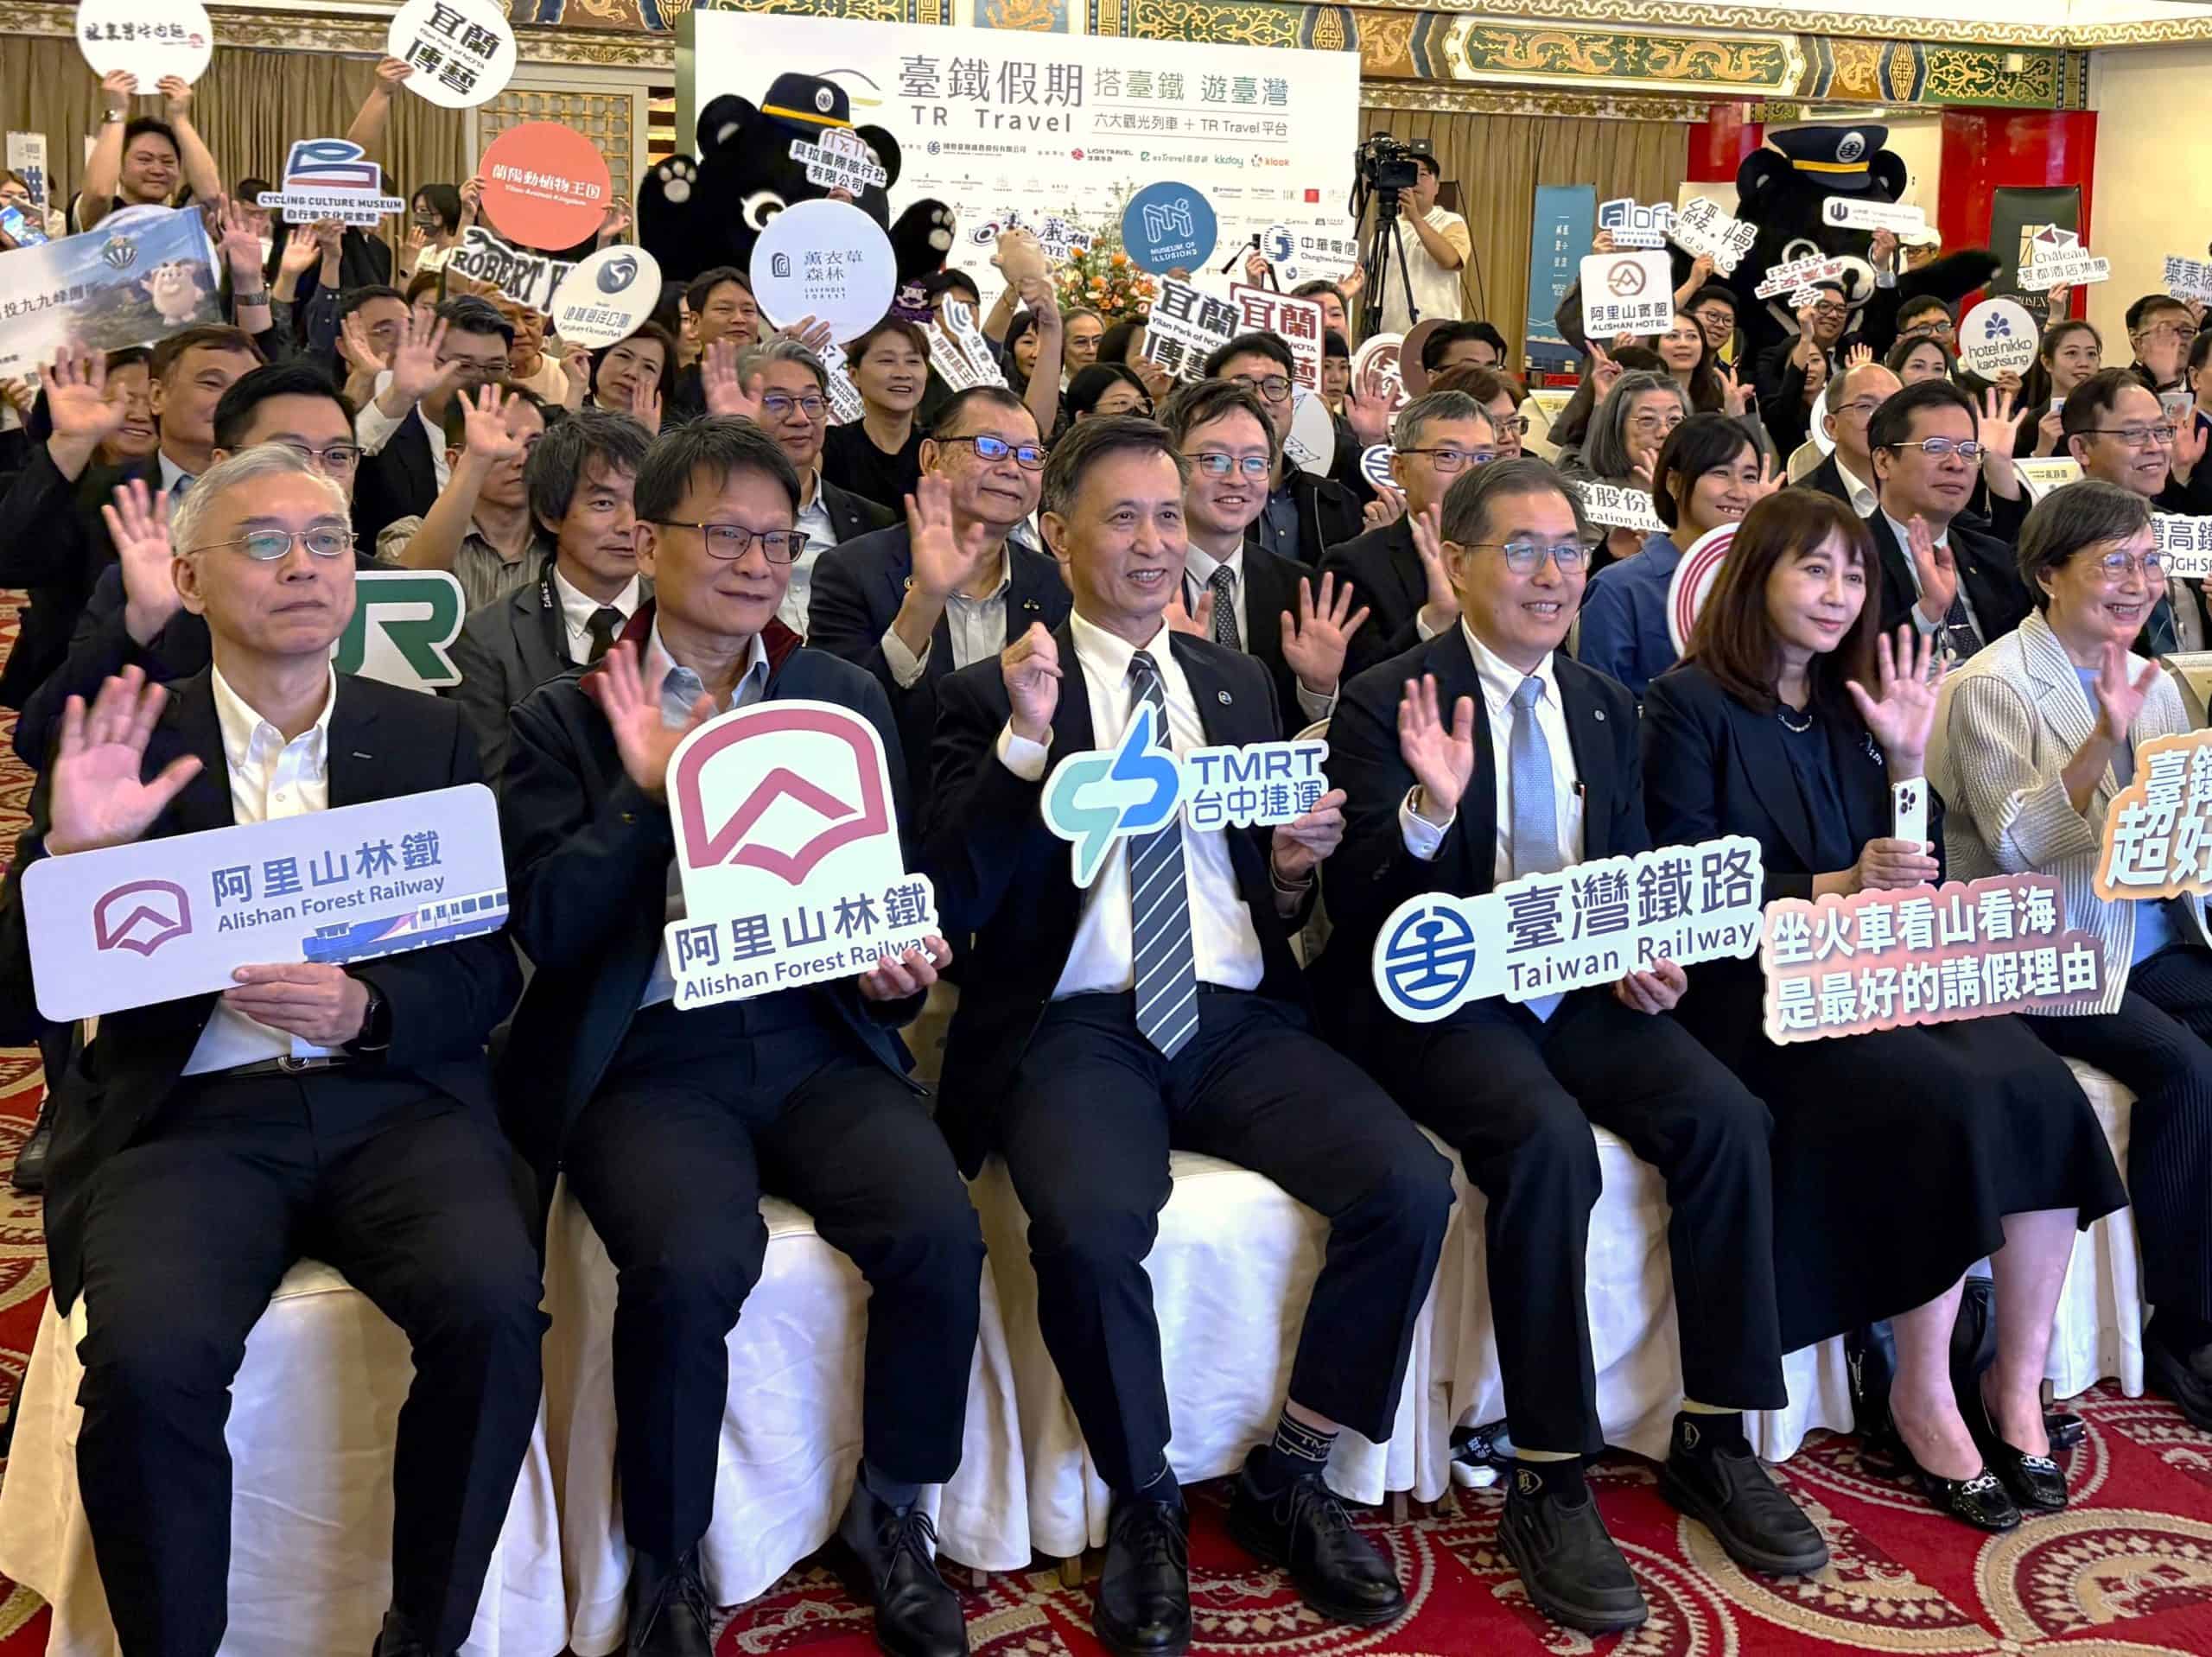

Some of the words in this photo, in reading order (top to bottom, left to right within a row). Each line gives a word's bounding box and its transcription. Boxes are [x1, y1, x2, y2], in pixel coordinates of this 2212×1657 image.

[423, 1, 503, 60] 宜蘭
[405, 37, 480, 95] 傳藝
[899, 54, 1083, 107] 臺鐵假期
[1094, 67, 1184, 101] 搭臺鐵
[1200, 74, 1288, 106] 遊臺灣
[911, 105, 948, 126] TR
[975, 108, 1071, 132] Travel
[1095, 112, 1178, 130] 六大觀光列車
[1200, 118, 1218, 131] TR
[1223, 120, 1260, 134] Travel
[1262, 121, 1287, 136] 平台
[794, 142, 886, 183] 貝拉國際旅行社
[812, 165, 864, 193] 有限公司
[1214, 155, 1244, 168] kkday
[1265, 158, 1290, 167] klook
[261, 194, 307, 205] CYCLING
[308, 196, 355, 207] CULTURE
[358, 200, 402, 209] MUSEUM
[1602, 201, 1673, 229] aloft
[1150, 243, 1184, 256] MUSEUM
[1151, 249, 1198, 263] ILLUSIONS
[1301, 237, 1357, 256] 中華電信
[451, 250, 546, 303] ROBERT
[804, 267, 844, 282] 森林
[1155, 278, 1242, 339] 宜蘭
[1239, 295, 1317, 340] 宜蘭
[1590, 302, 1668, 321] 阿里山賓館
[1592, 321, 1633, 332] ALISHAN
[1636, 320, 1669, 329] HOTEL
[1152, 316, 1173, 330] Yilan
[1173, 322, 1192, 339] Park
[1192, 332, 1203, 342] of
[1968, 341, 1999, 359] hotel
[2000, 339, 2032, 353] nikko
[1977, 354, 2030, 371] kaohsiung
[1191, 747, 1322, 784] TMRT
[1193, 780, 1322, 823] 台中捷運
[212, 830, 442, 907] 阿里山林鐵
[218, 909, 296, 933] Alishan
[302, 890, 365, 916] Forest
[369, 875, 446, 903] Railway
[1504, 848, 1755, 954] 臺灣鐵路
[675, 882, 930, 972] 阿里山林鐵
[1770, 885, 2056, 966] 坐火車看山看海
[683, 970, 769, 1000] Alishan
[774, 951, 846, 981] Forest
[850, 936, 928, 965] Railwa
[1507, 949, 1619, 991] Taiwan
[1637, 922, 1755, 964] Railway
[1777, 942, 2098, 1032] 是最好的請假理由
